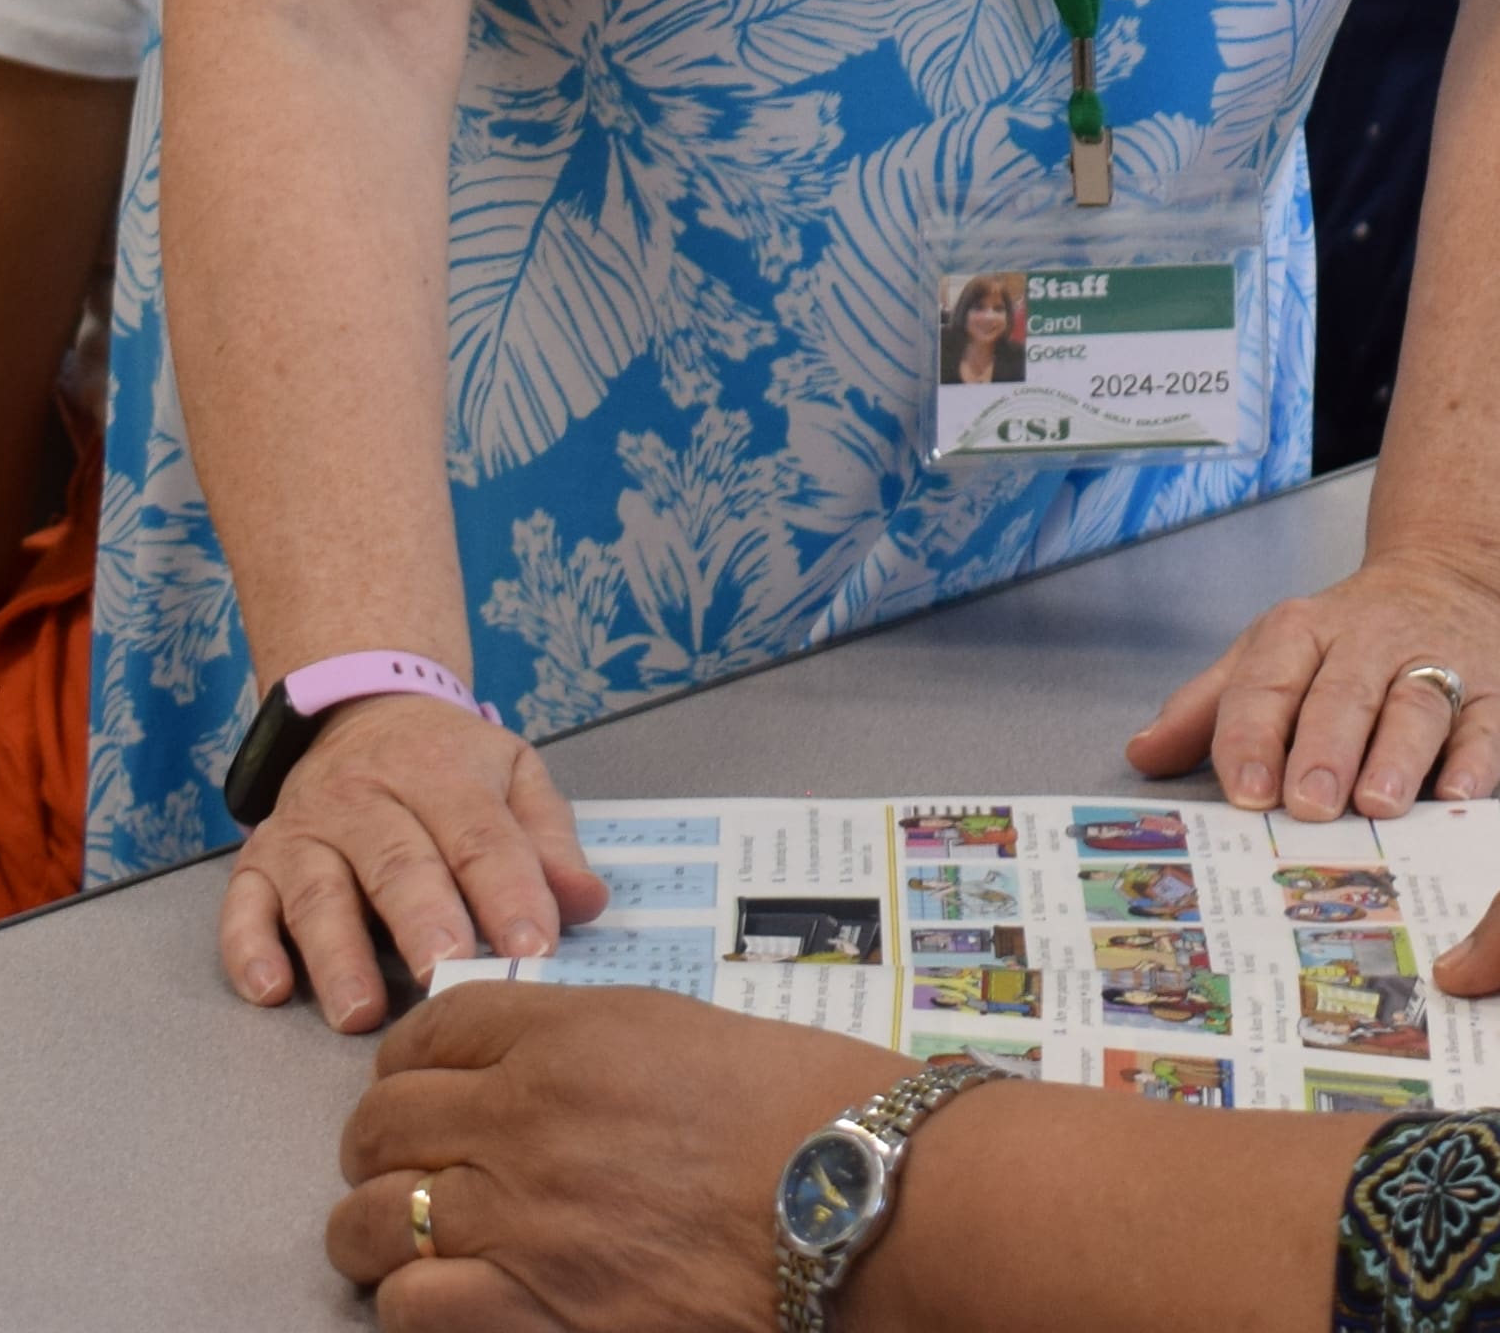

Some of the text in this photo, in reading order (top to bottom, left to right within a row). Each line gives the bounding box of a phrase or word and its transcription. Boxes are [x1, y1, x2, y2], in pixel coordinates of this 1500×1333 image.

[1027, 274, 1110, 301] Staff
[1027, 314, 1082, 334] Carol
[1027, 343, 1088, 363] Goetz
[1089, 370, 1230, 399] 2024-2025
[996, 417, 1072, 443] CSJ
